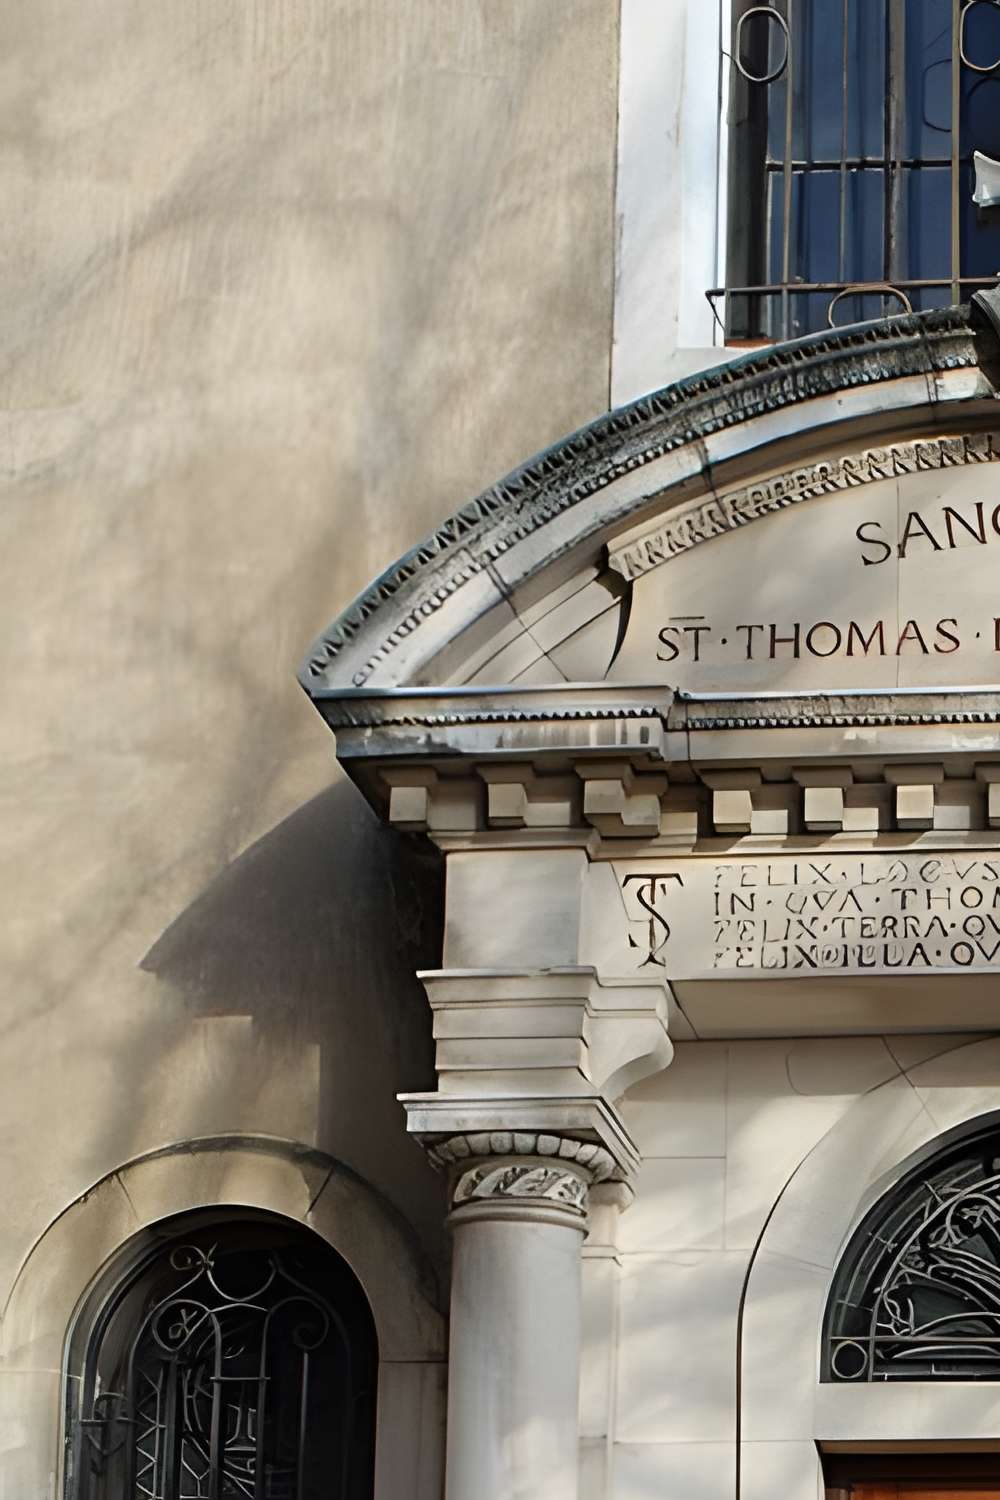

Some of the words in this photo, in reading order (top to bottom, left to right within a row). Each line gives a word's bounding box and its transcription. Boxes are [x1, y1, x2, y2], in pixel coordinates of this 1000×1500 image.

[736, 618, 960, 659] THOMAS
[714, 892, 756, 915] IN
[832, 915, 949, 938] TERRA
